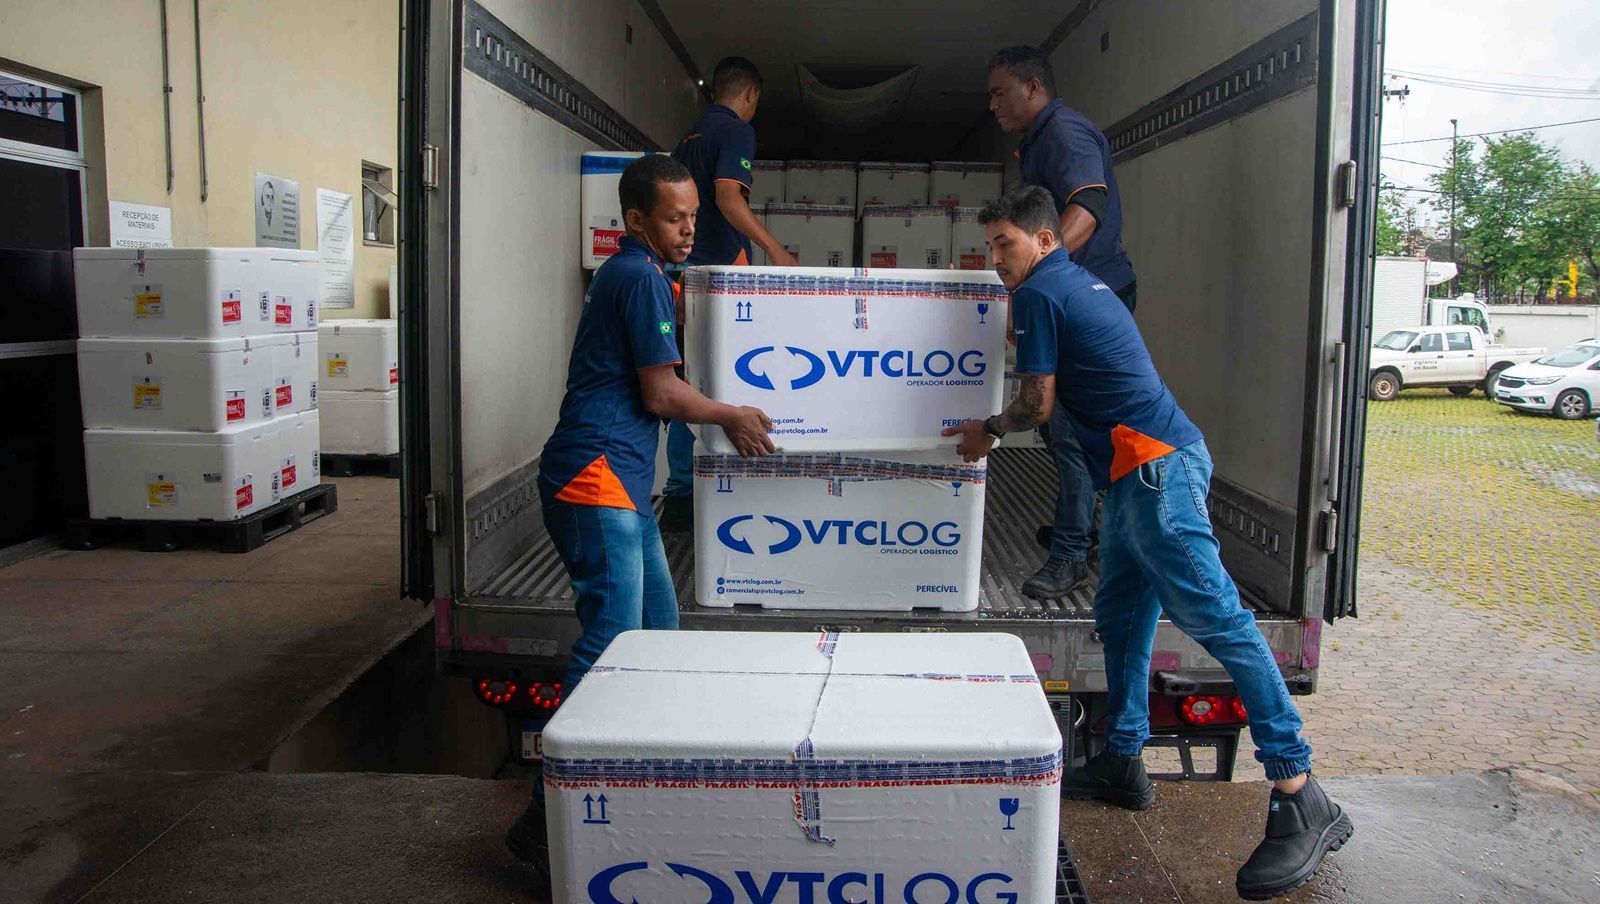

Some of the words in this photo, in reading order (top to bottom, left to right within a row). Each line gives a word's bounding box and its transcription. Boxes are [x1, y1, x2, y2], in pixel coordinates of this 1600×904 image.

[152, 213, 160, 222] DE
[127, 220, 155, 230] MATERIAIS
[594, 234, 615, 243] FRÁGIL
[116, 240, 138, 248] ACESSO
[827, 350, 987, 378] VTCLOG
[802, 520, 961, 547] VTCLOG
[920, 547, 959, 555] LOGÍSTICO
[726, 577, 782, 586] www.vtclog.com.br
[726, 586, 805, 596] comercialsp@vtclog.com.br
[916, 584, 958, 593] PERECÍVEL
[734, 871, 1018, 904] VTCLOG
